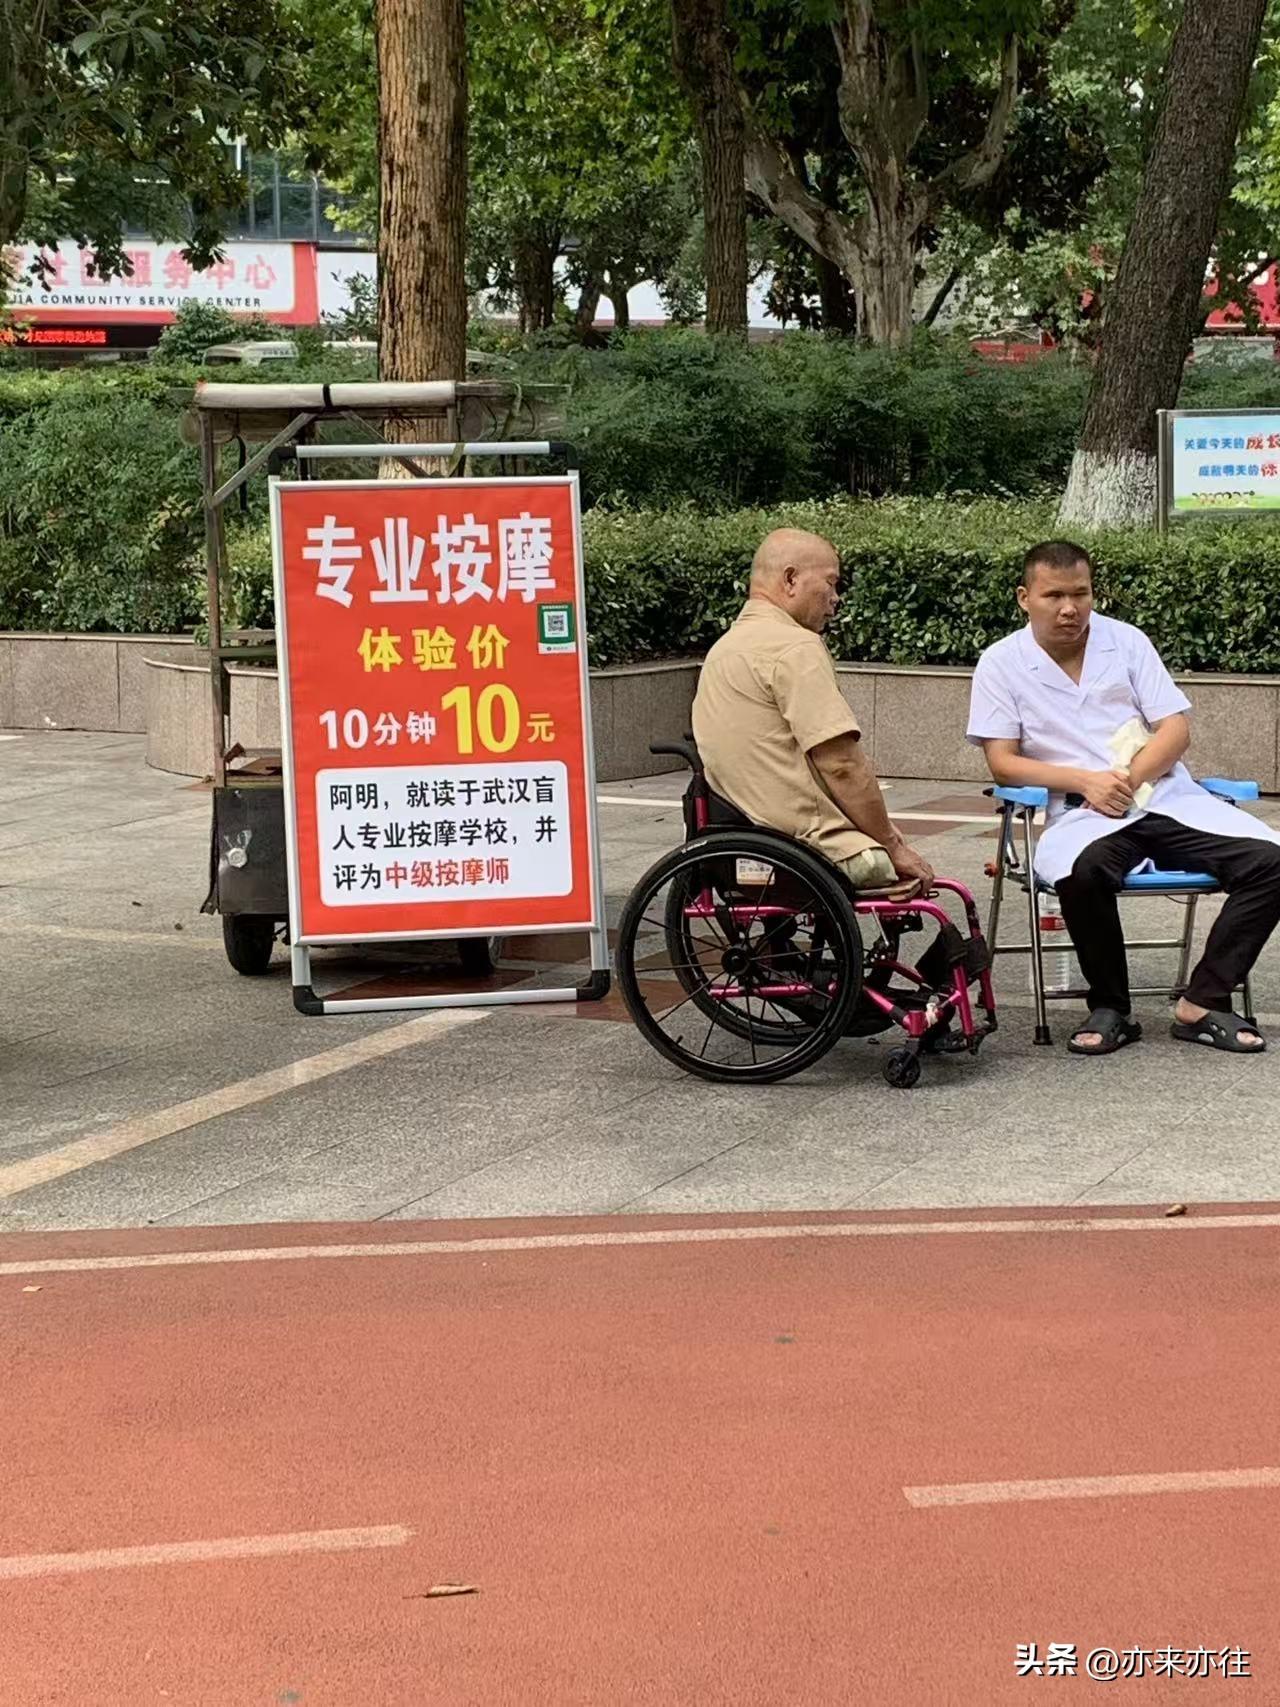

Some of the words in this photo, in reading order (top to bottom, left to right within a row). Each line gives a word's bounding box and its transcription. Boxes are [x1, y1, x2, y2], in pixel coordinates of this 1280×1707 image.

[41, 295, 131, 305] COMMUNITY
[302, 511, 556, 608] 专业按摩
[357, 624, 510, 673] 体验价
[329, 776, 556, 811] 阿明，就读于武汉盲
[332, 815, 558, 851] 人专业按摩学校，并
[333, 857, 510, 891] 评为中级按摩师
